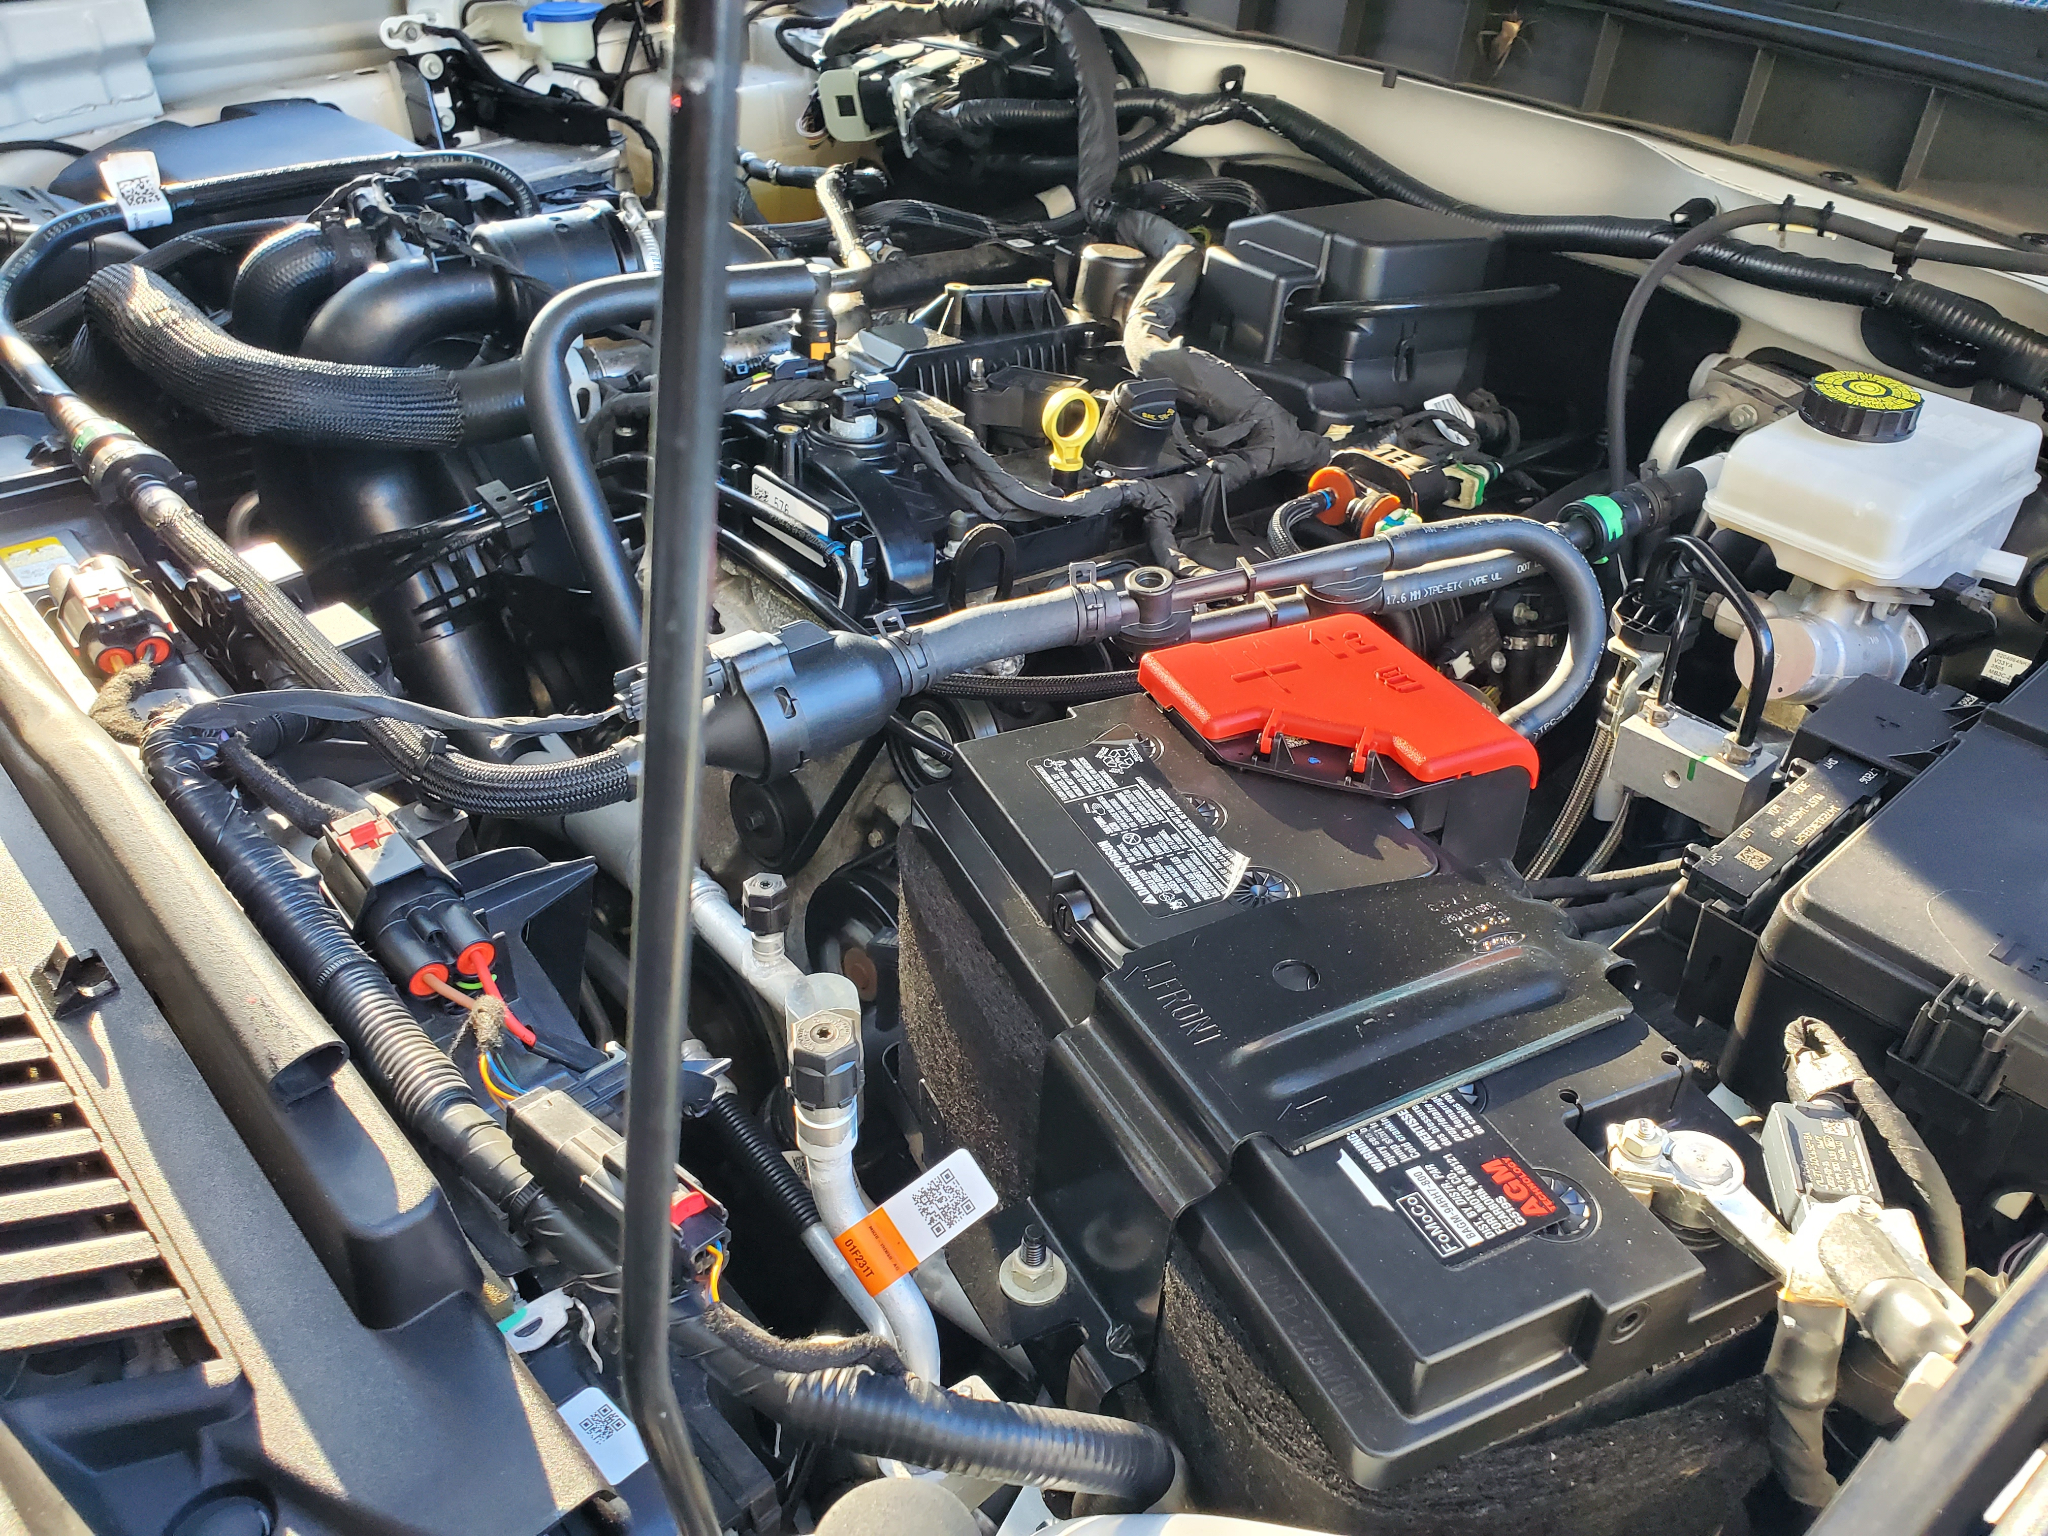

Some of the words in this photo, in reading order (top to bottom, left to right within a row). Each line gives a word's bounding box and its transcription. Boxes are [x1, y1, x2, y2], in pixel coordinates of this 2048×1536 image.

[1515, 560, 1532, 573] DOT
[1096, 839, 1151, 896] DANGER/POISON
[1394, 1108, 1443, 1152] AVERTISSE
[1407, 1104, 1442, 1134] blessure
[1470, 1123, 1485, 1135] de
[1434, 1132, 1453, 1147] des
[1460, 1128, 1475, 1138] de
[1373, 1144, 1401, 1168] injury
[1387, 1142, 1412, 1163] jump
[1399, 1140, 1422, 1159] Cold
[1422, 1161, 1445, 1180] PAR
[1441, 1152, 1469, 1175] 48121
[1442, 1168, 1463, 1185] CO.
[1460, 1174, 1478, 1186] MI
[1498, 1155, 1562, 1212] TECHNOLOGY
[1436, 1178, 1469, 1206] DISTR.
[1454, 1183, 1487, 1212] MOTOR
[1476, 1157, 1552, 1221] AGM
[1409, 1170, 1479, 1239] BAGM-94RH7-800
[1459, 1204, 1479, 1219] BY
[1469, 1183, 1521, 1230] DEARBORN,
[1492, 1194, 1529, 1226] G519S
[1400, 1194, 1460, 1253] FoMoCo
[1470, 1216, 1497, 1239] DIST.
[1479, 1210, 1507, 1234] FORD
[843, 1237, 875, 1279] 01F231T
